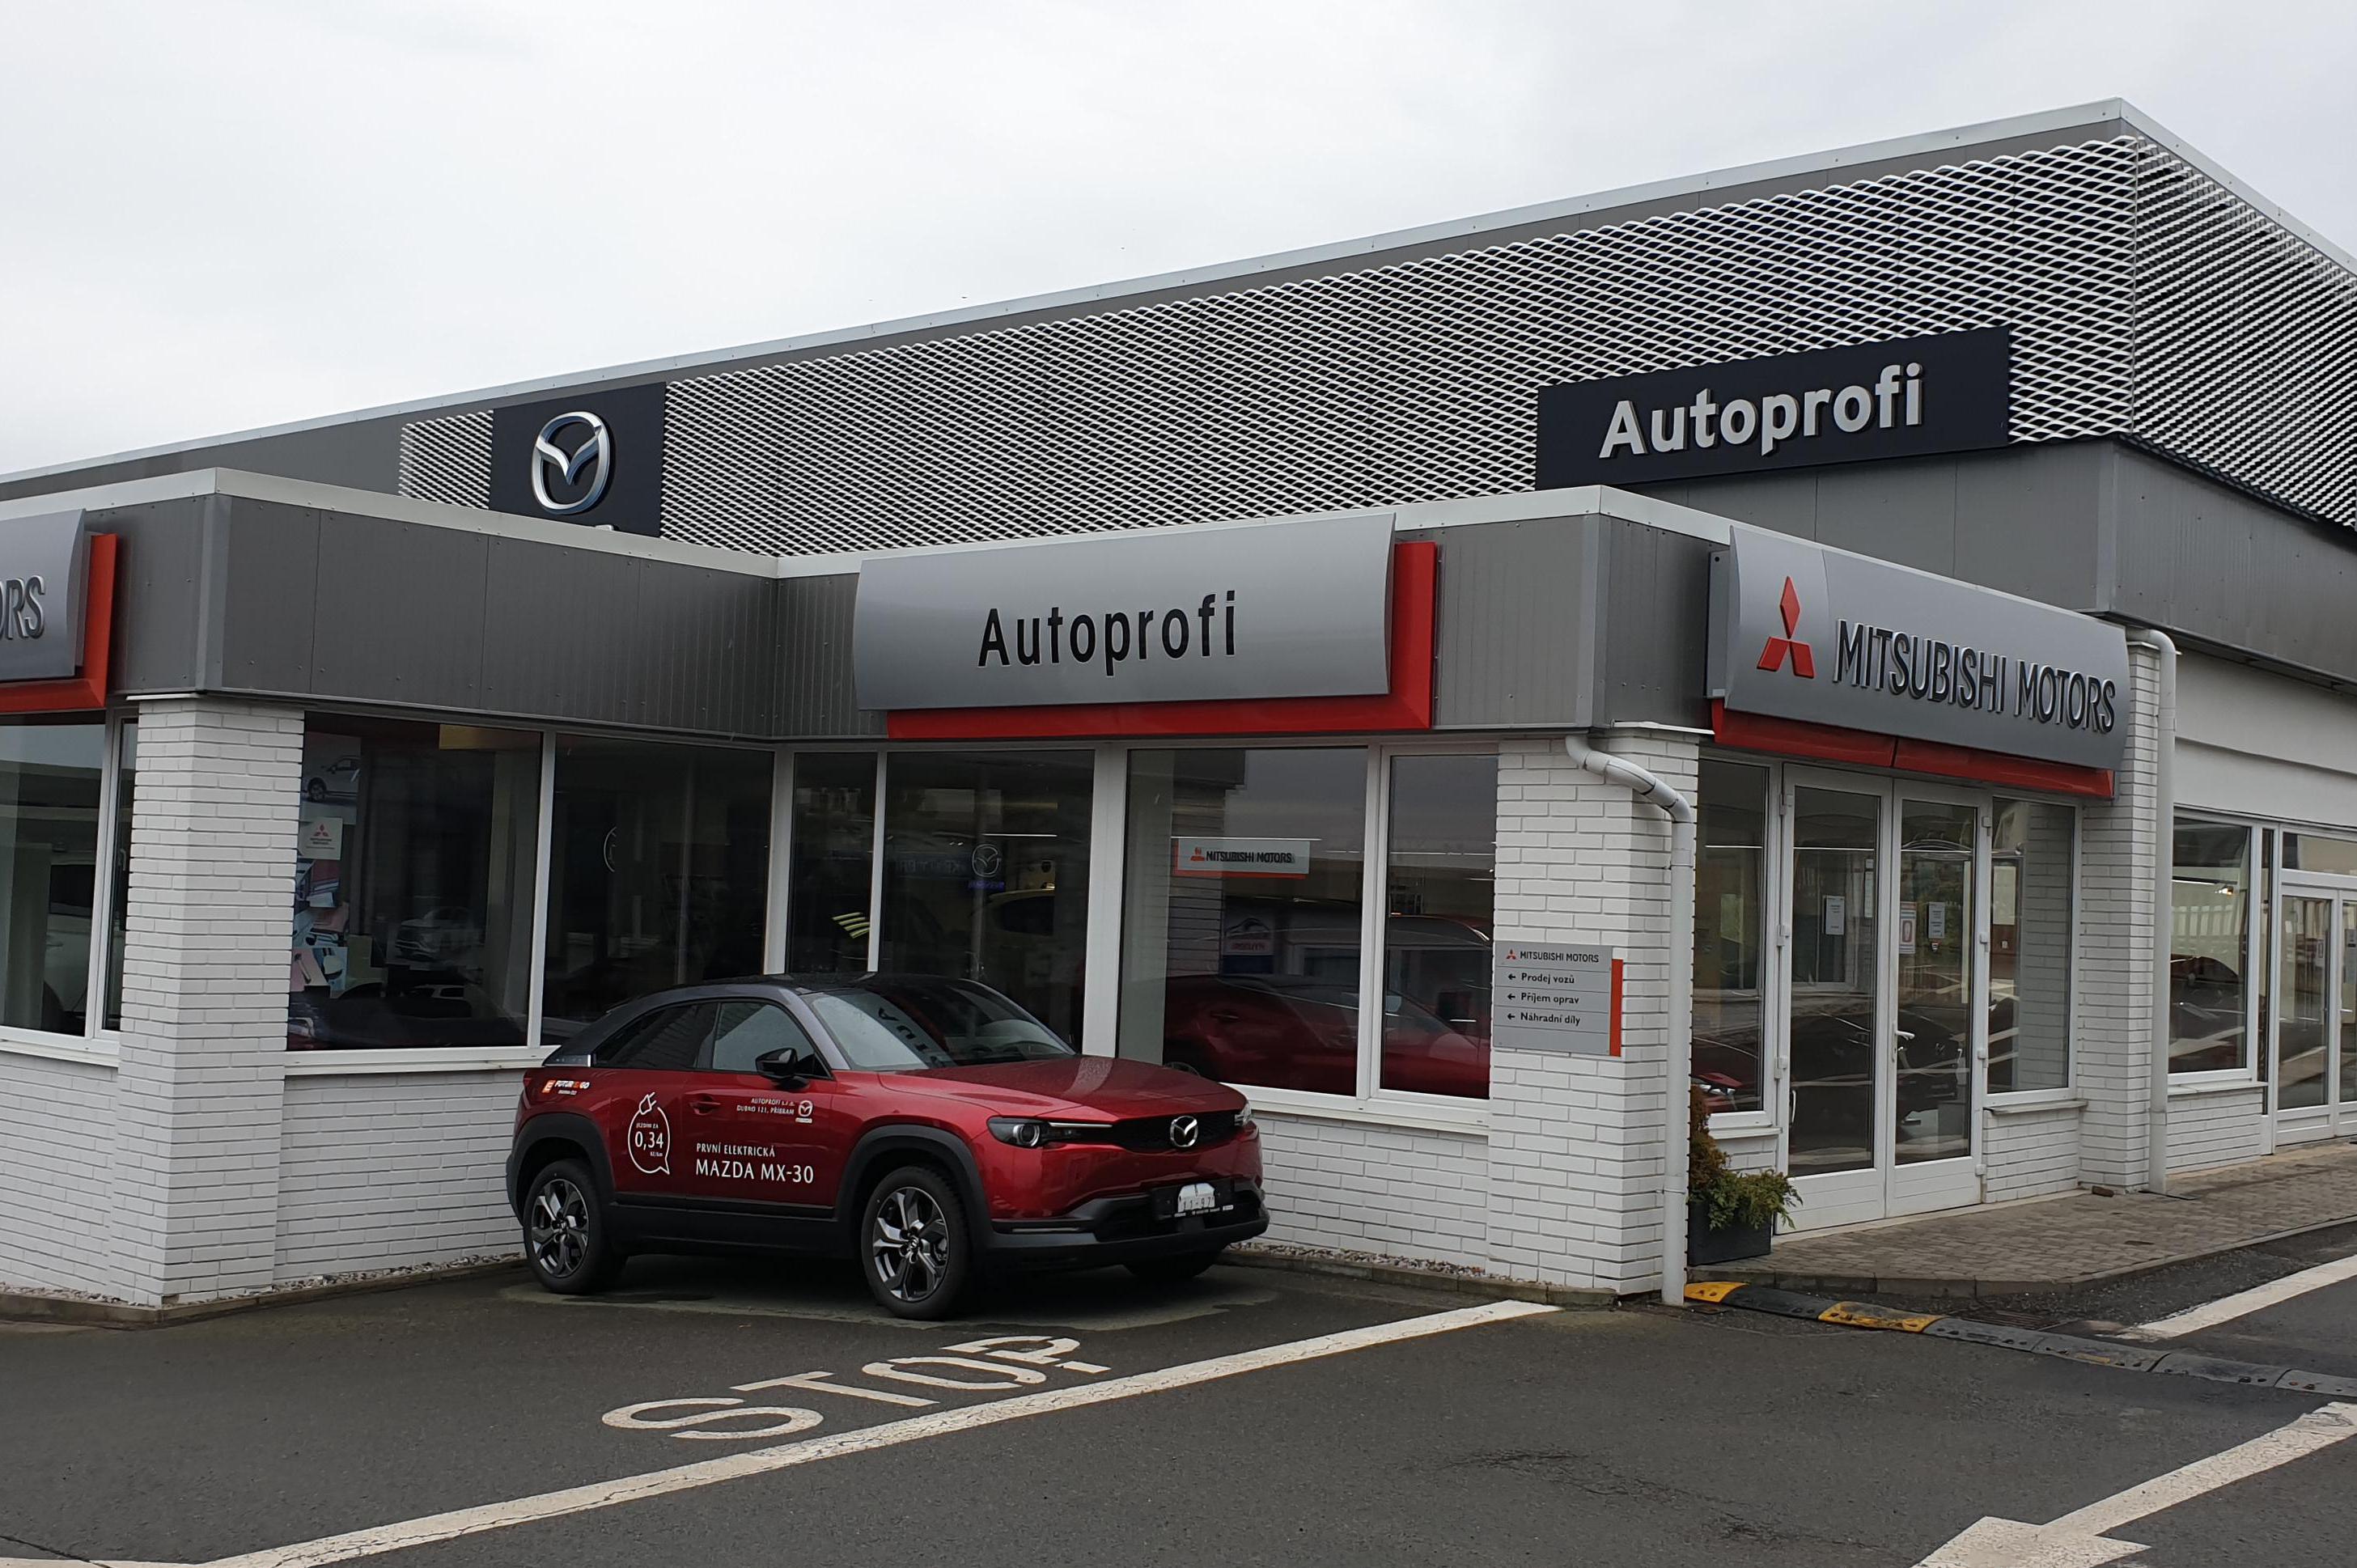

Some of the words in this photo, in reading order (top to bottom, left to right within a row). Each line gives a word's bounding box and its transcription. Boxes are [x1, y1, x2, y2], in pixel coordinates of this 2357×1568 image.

[1599, 362, 1924, 459] Autoprofi
[0, 575, 45, 640] RS
[977, 590, 1236, 677] Autoprofi
[1833, 619, 2007, 713] MITSUBISHI
[2014, 659, 2116, 733] MOTORS
[1520, 951, 1564, 961] MITSUBISHI
[1566, 953, 1599, 963] MOTORS
[1521, 973, 1551, 985] Prodej
[1554, 974, 1575, 984] vozů
[1521, 992, 1551, 1003] Příjem
[1553, 996, 1580, 1006] oprav
[1520, 1011, 1562, 1023] Náhradní
[1564, 1015, 1581, 1027] díly
[751, 1097, 781, 1105] AUTOPROFI
[634, 1131, 664, 1151] 0,34
[697, 1142, 721, 1154] PRVNÍ
[724, 1144, 775, 1158] ELEKTRICKÁ
[696, 1158, 754, 1180] MAZDA
[761, 1163, 814, 1184] MX-30
[601, 1335, 1111, 1439] STOP
